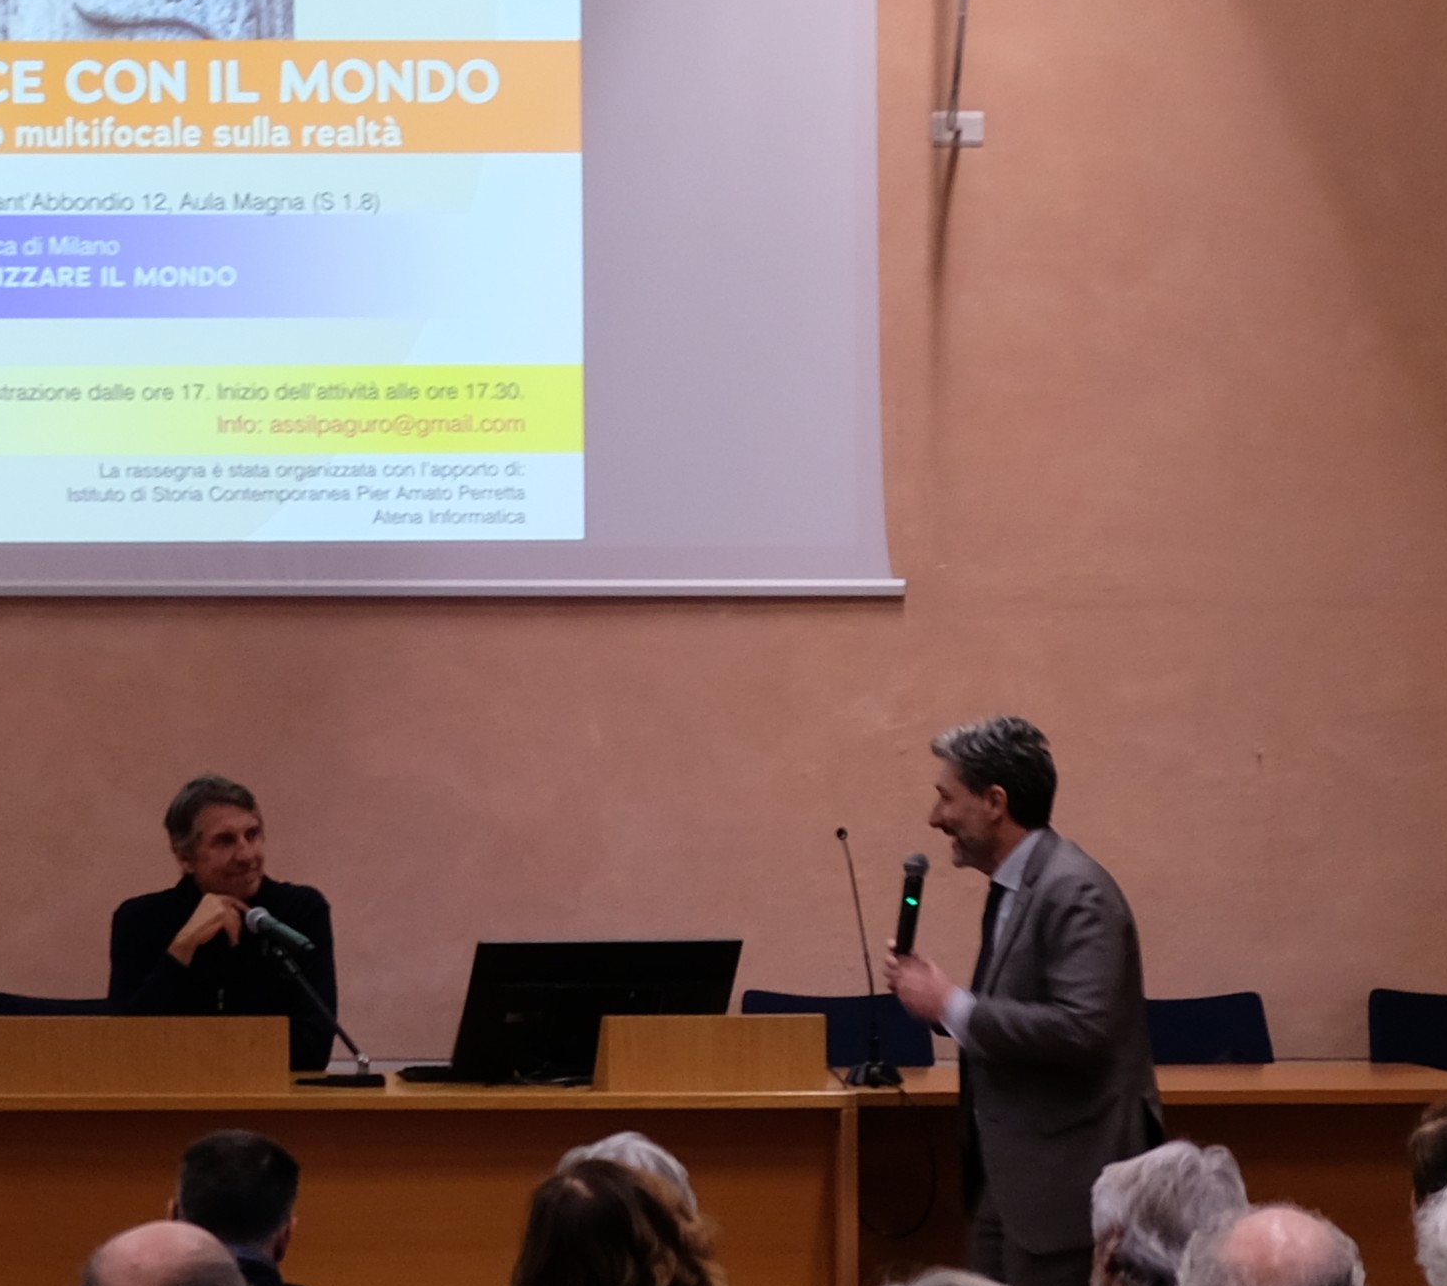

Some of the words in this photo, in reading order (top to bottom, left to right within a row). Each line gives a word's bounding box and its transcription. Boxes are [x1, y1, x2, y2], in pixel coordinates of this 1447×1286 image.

[65, 59, 187, 103] CON
[209, 59, 259, 103] IL
[279, 59, 500, 103] MONDO
[15, 116, 200, 148] multifocale
[213, 116, 290, 148] sulla
[302, 116, 402, 148] realtà
[142, 193, 172, 215] 12,
[179, 193, 225, 214] Aula
[232, 193, 304, 216] Magna
[312, 193, 334, 216] (S
[343, 193, 381, 216] 1.8)
[22, 236, 42, 257] di
[48, 237, 120, 256] Milano
[101, 267, 125, 288] IL
[134, 267, 237, 288] MONDO
[87, 384, 135, 401] dalle
[142, 387, 174, 401] ore
[180, 382, 210, 402] 17.
[217, 382, 269, 402] Inizio
[275, 382, 380, 402] dell'attività
[386, 382, 419, 402] alle
[426, 386, 458, 402] ore
[465, 382, 525, 402] 17.30.
[217, 415, 263, 434] Info:
[270, 414, 526, 438] assilpaguro@gmail.com
[99, 462, 120, 478] La
[125, 465, 206, 483] rassegna
[212, 462, 223, 478] è
[229, 462, 271, 478] stata
[277, 462, 378, 483] organizzata
[383, 466, 416, 478] con
[422, 462, 499, 482] l'apporto
[505, 462, 525, 478] di:
[67, 486, 125, 502] Istituto
[131, 486, 146, 502] di
[152, 486, 203, 502] Storia
[208, 486, 351, 506] Contemporanea
[357, 486, 390, 502] Pier
[396, 486, 453, 502] Amato
[458, 486, 526, 502] Perretta
[373, 509, 423, 526] Atena
[429, 509, 526, 526] Informatica
